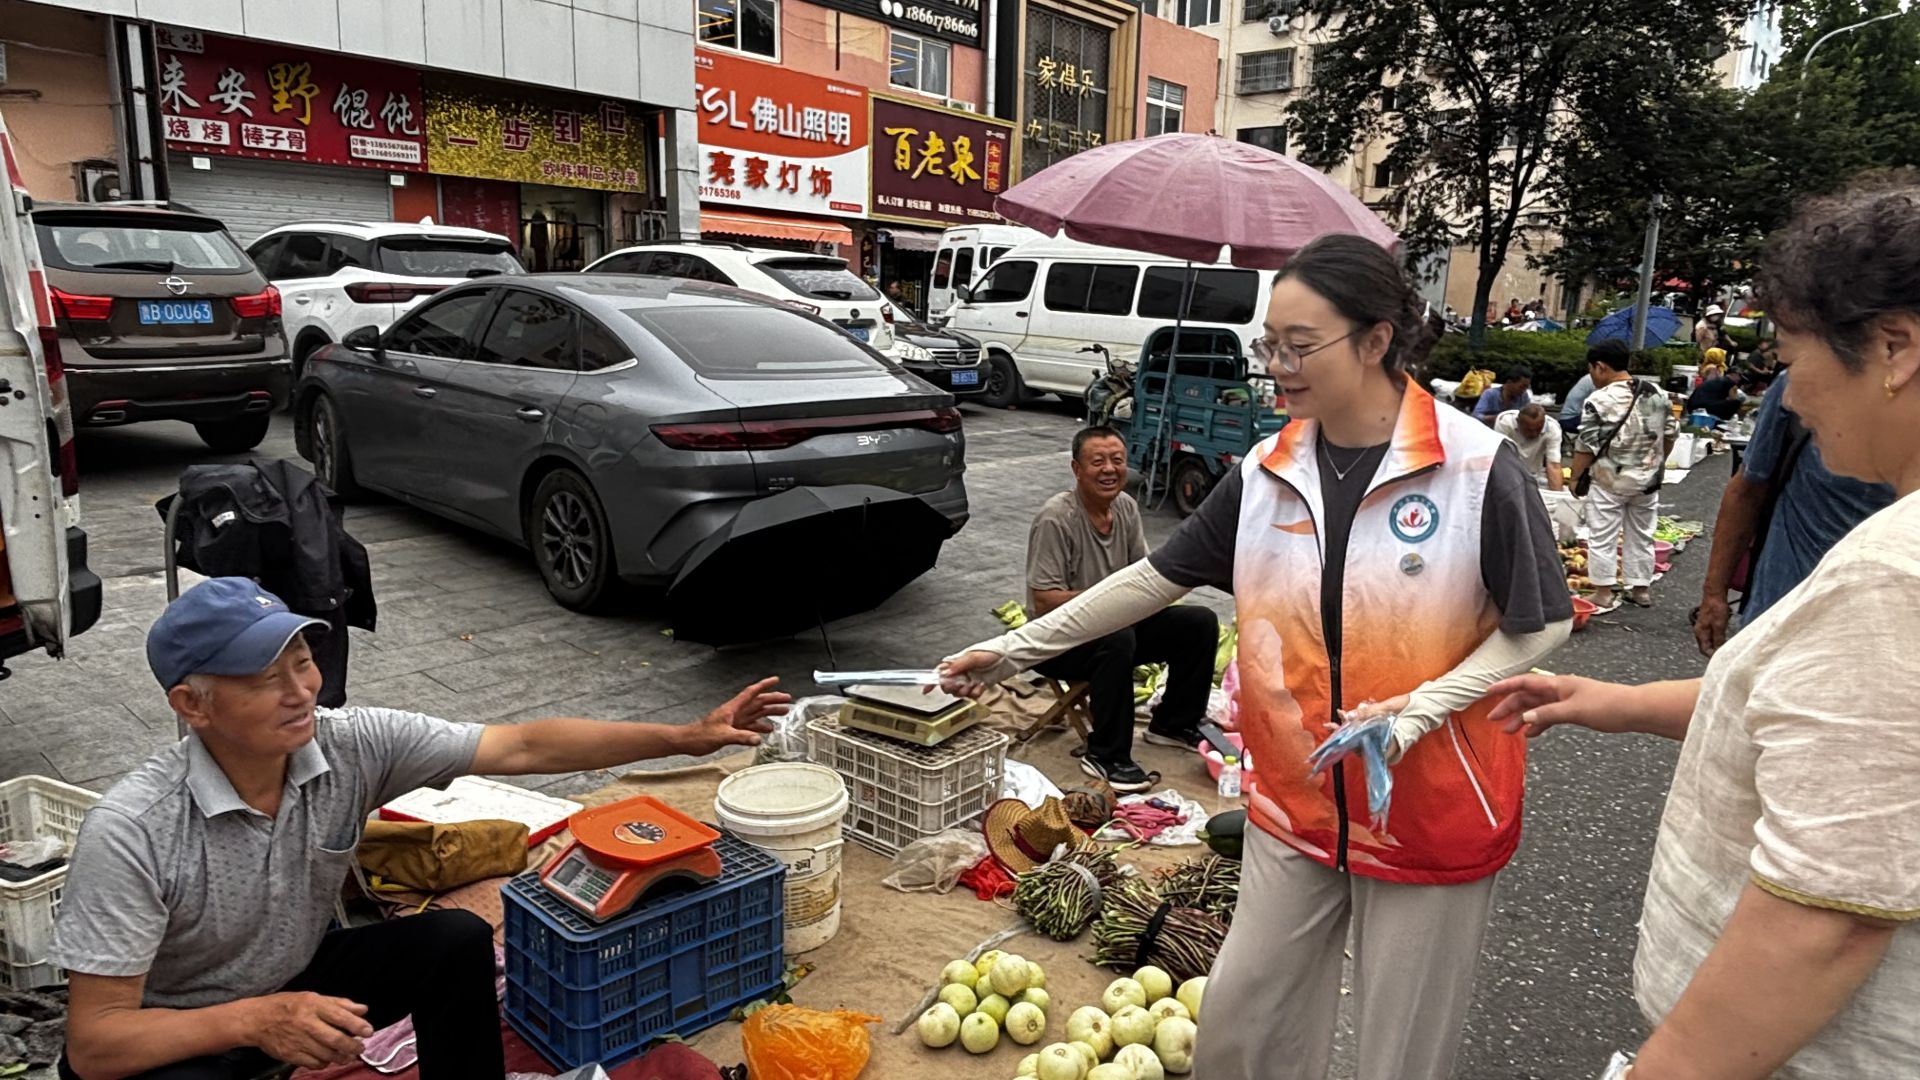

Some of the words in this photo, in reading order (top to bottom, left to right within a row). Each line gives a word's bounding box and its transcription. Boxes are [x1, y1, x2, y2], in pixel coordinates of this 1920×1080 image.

[906, 6, 978, 38] 18661786606
[161, 54, 421, 136] 来安野馄饨
[167, 117, 224, 142] 烧烤
[243, 125, 306, 150] 棒子骨
[448, 101, 627, 152] 一步到位
[750, 95, 851, 145] 佛山照明
[542, 160, 639, 186] 欧韩精品女装
[708, 150, 833, 199] 亮家灯饰
[884, 126, 981, 186] 百老泉
